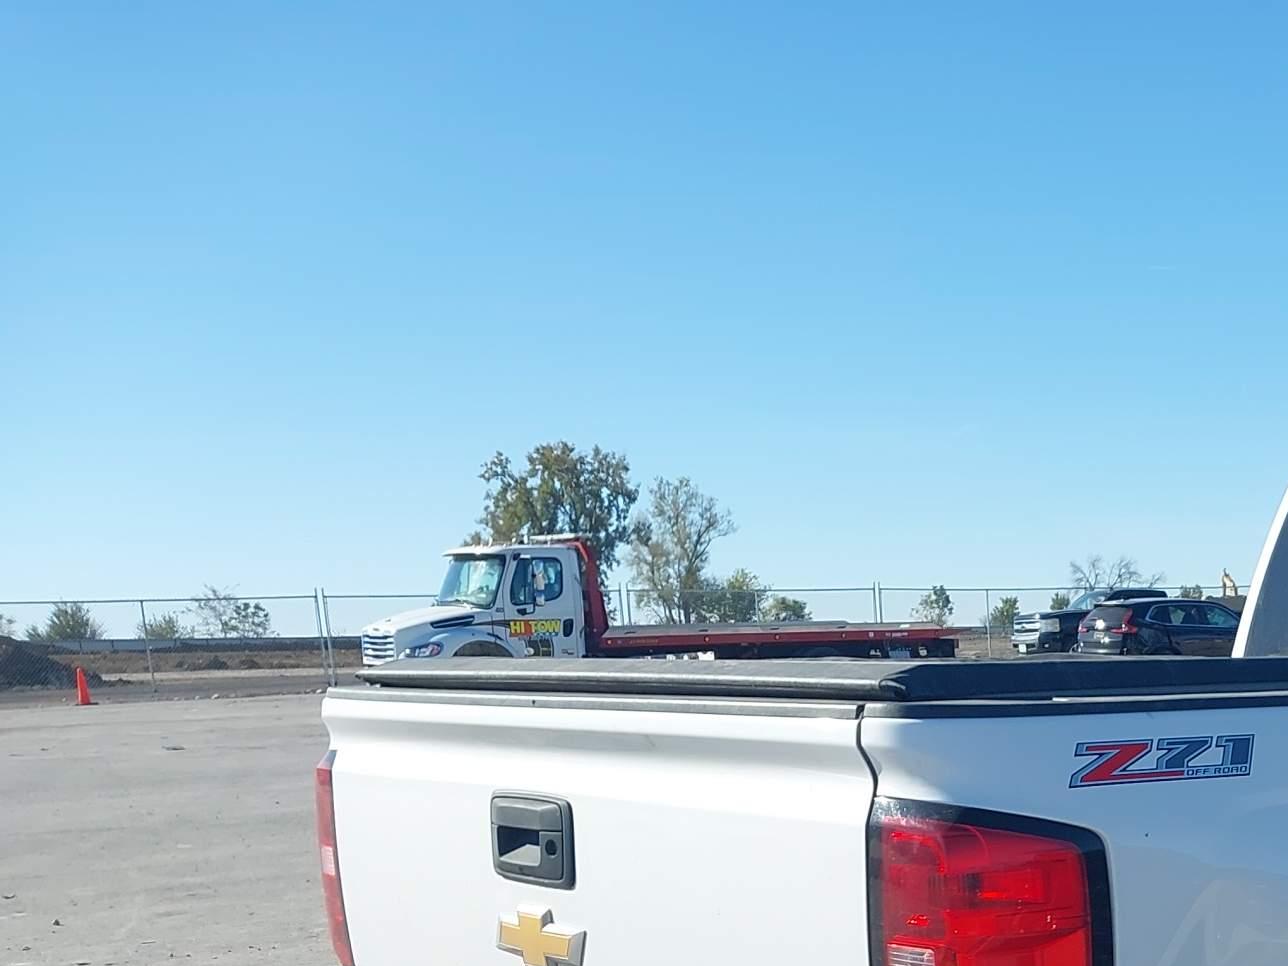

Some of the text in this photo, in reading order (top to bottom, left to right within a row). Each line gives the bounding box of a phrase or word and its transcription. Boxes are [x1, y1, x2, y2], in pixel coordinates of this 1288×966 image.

[509, 620, 561, 634] HI TOW
[1068, 733, 1256, 789] Z71
[1186, 764, 1249, 777] OFF ROAD
